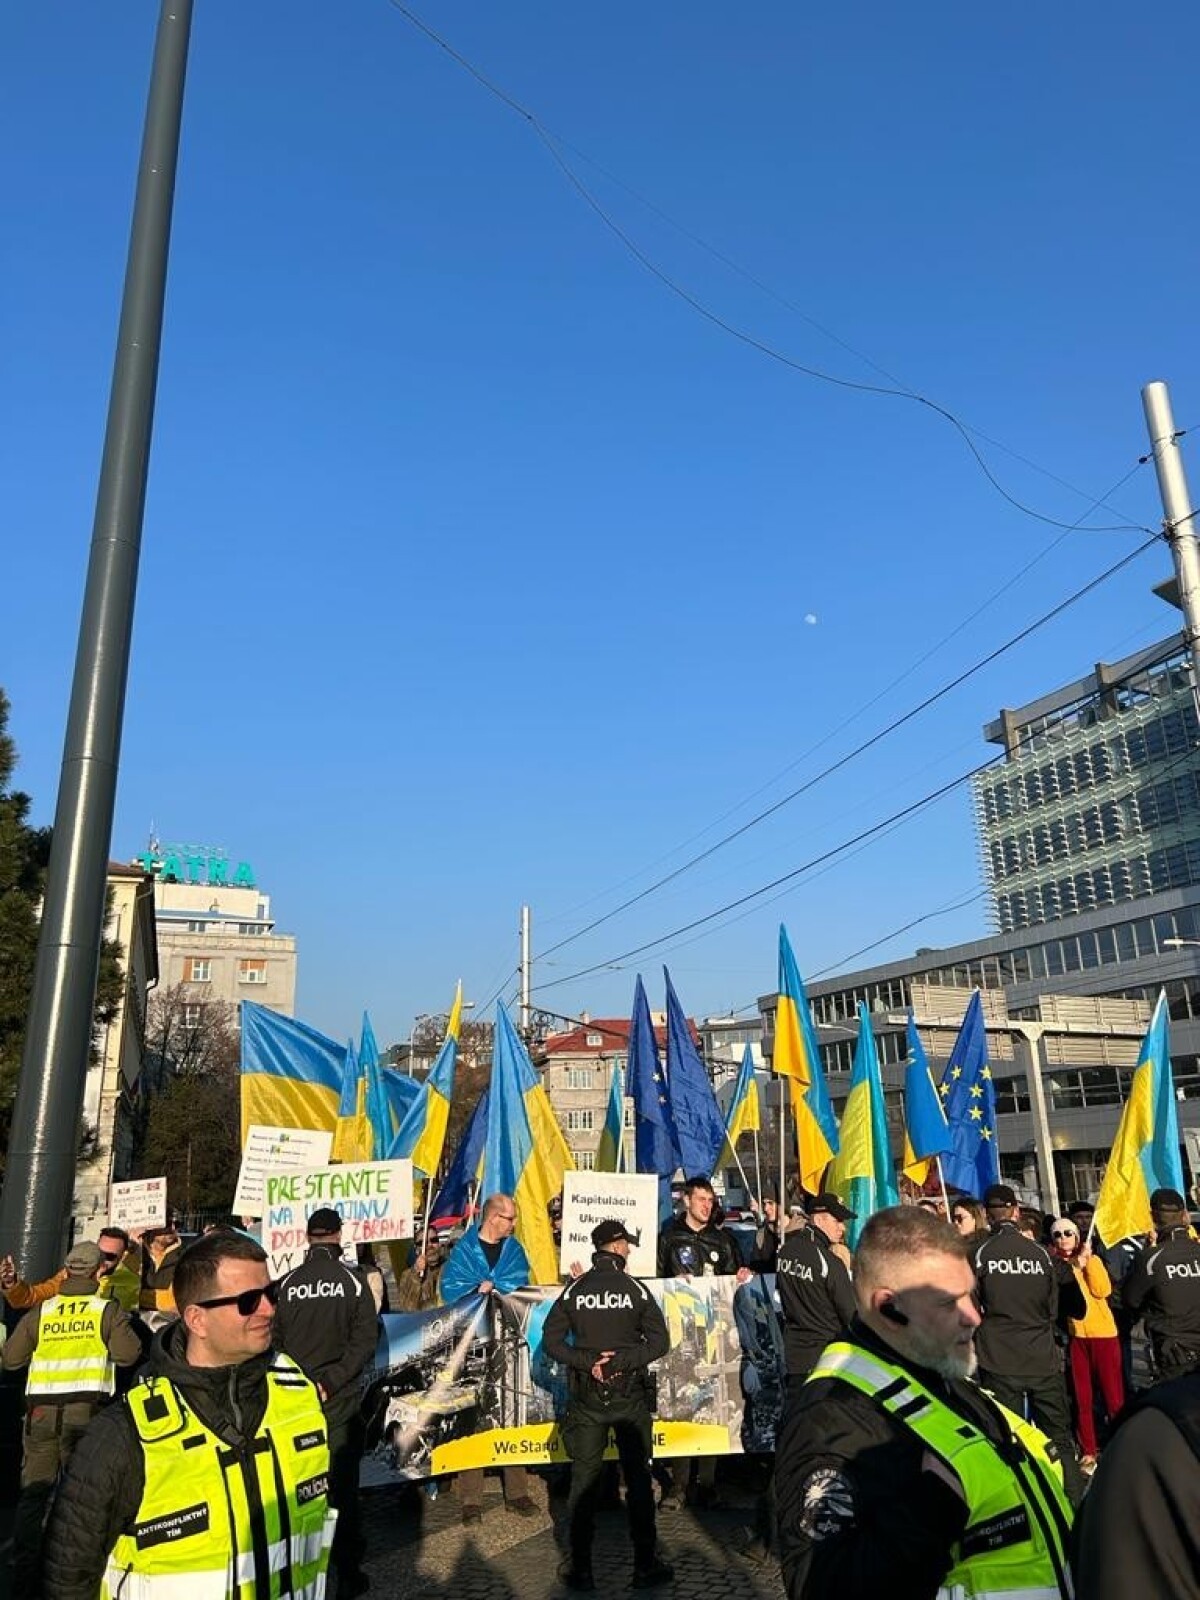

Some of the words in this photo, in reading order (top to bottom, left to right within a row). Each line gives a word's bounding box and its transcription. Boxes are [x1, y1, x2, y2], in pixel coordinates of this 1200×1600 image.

[137, 851, 256, 885] TATRA
[269, 1206, 293, 1228] NA
[569, 1232, 588, 1243] Nie
[988, 1256, 1045, 1275] POLÍCIA
[287, 1279, 345, 1302] POLÍCIA
[576, 1290, 633, 1310] POLÍCIA
[57, 1301, 89, 1315] 117
[494, 1440, 518, 1454] We
[520, 1437, 559, 1453] Stand
